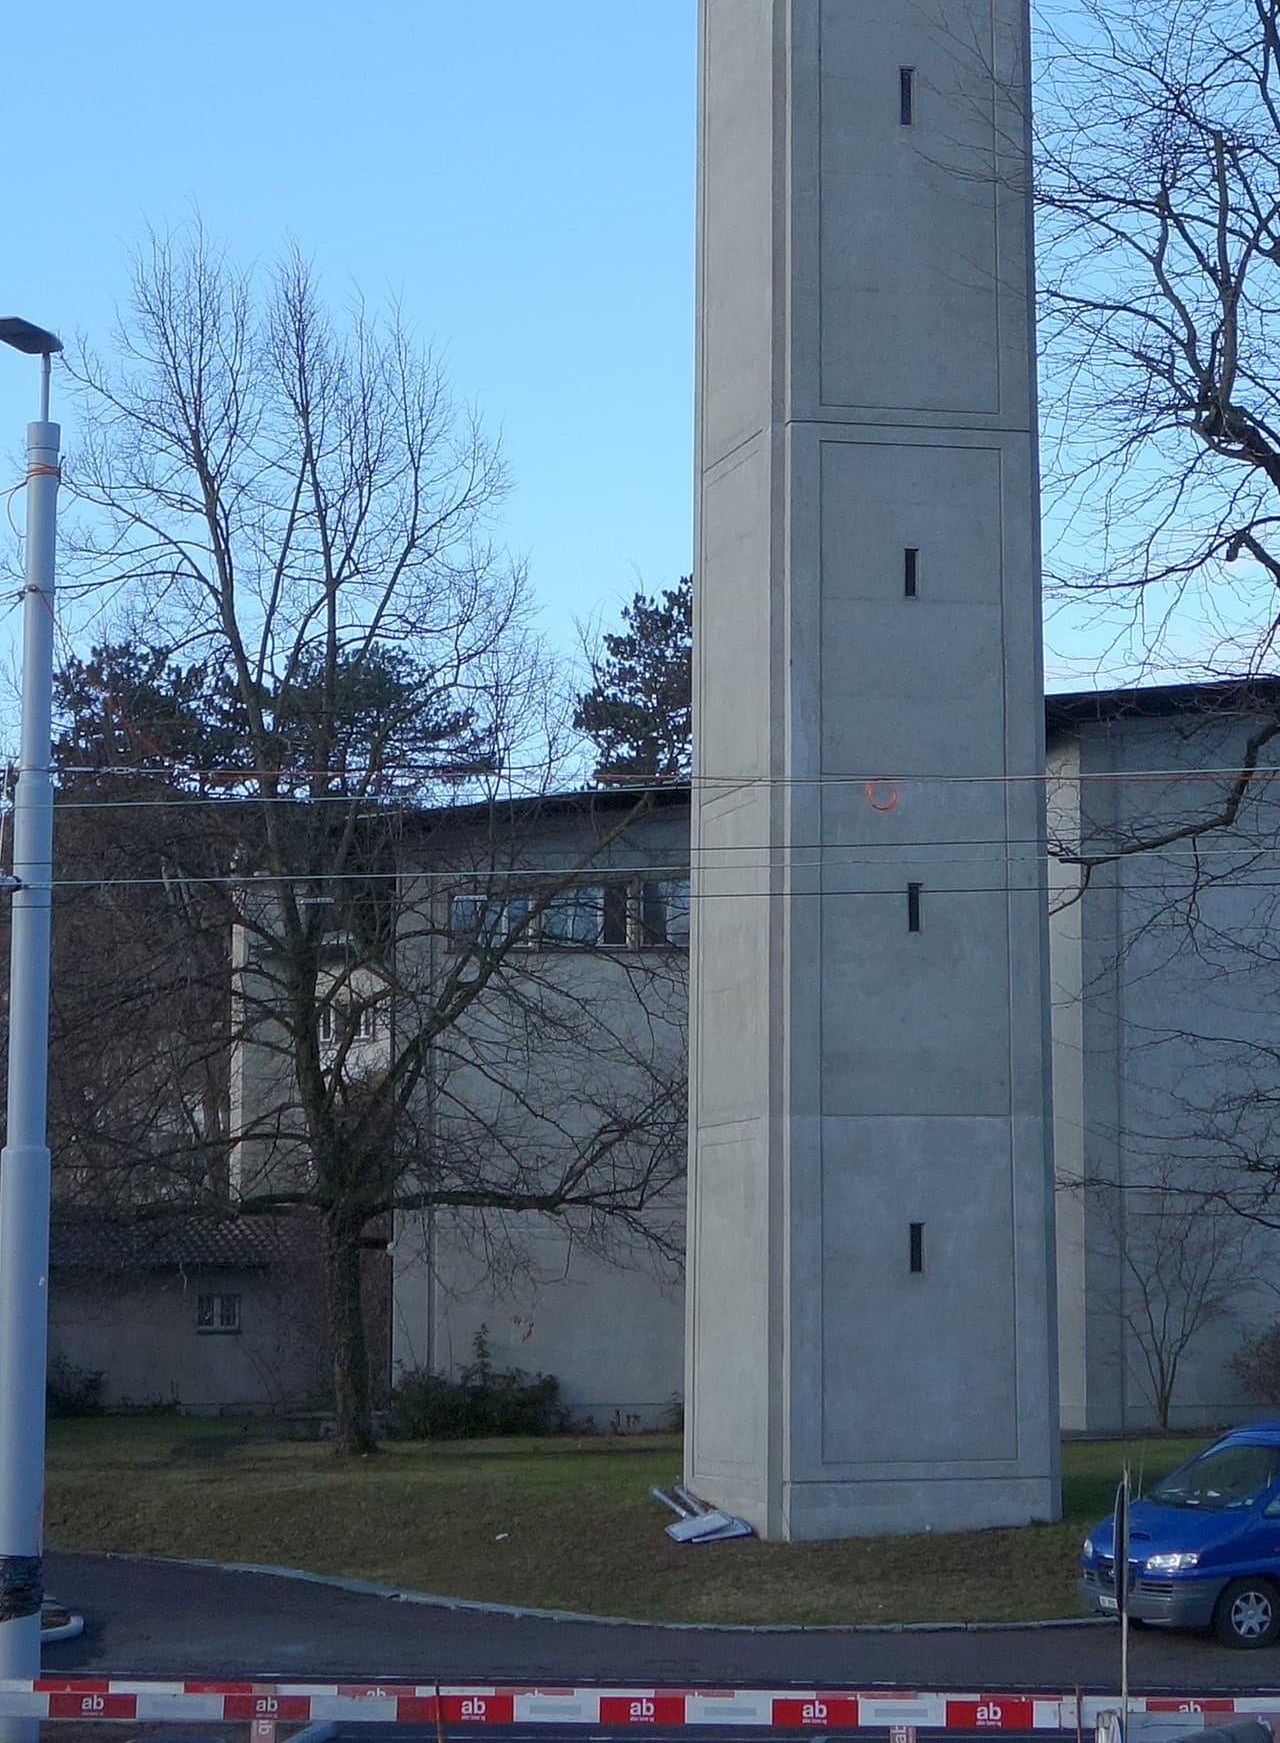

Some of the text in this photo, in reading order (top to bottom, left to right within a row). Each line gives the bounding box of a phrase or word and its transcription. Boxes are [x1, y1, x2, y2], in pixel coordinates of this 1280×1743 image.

[82, 1694, 104, 1710] ab
[256, 1696, 278, 1711] ab
[461, 1698, 485, 1714] ab
[630, 1698, 654, 1715] ab
[803, 1701, 827, 1718] ab
[976, 1703, 1001, 1720] ab
